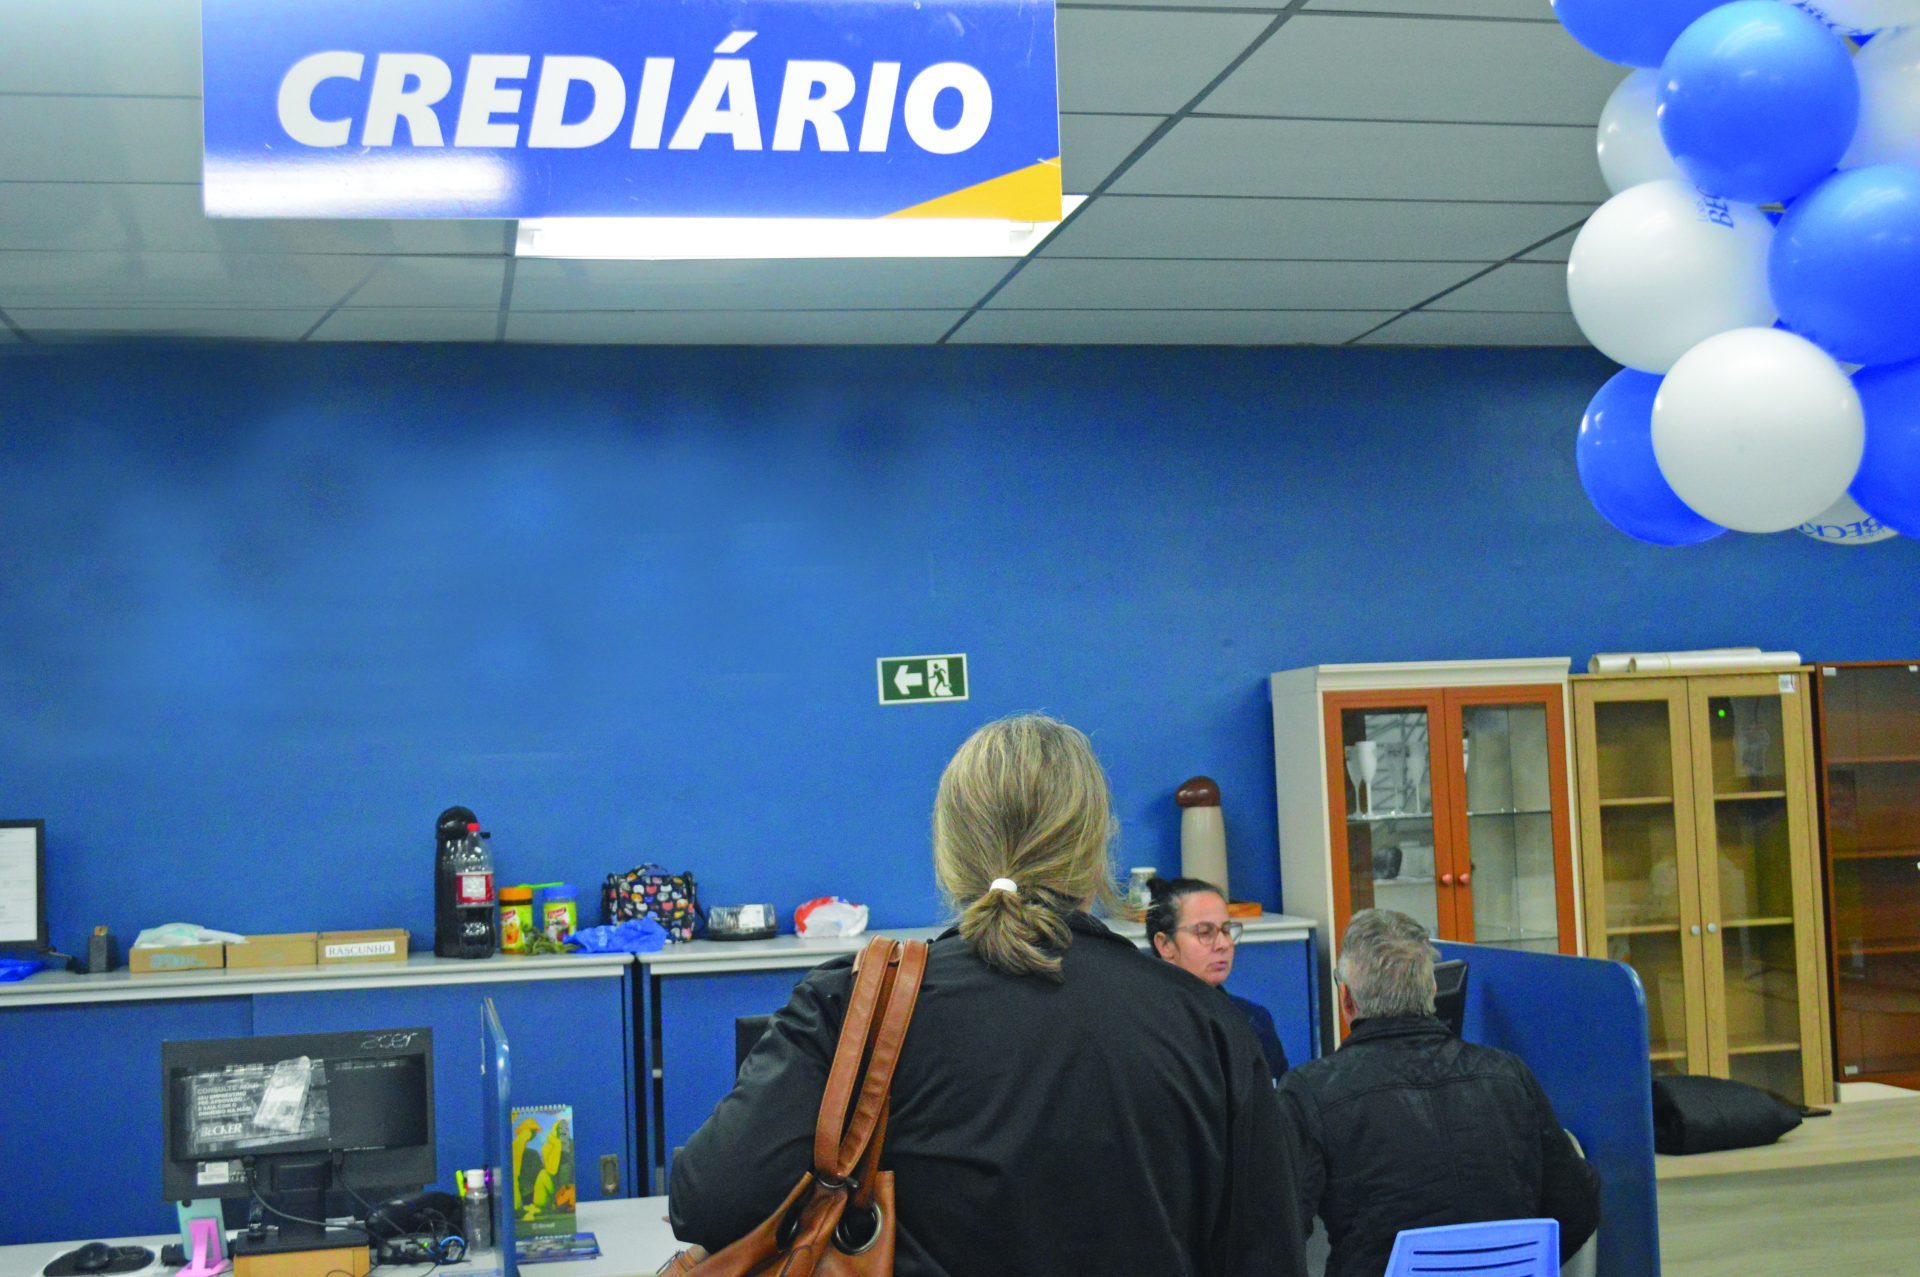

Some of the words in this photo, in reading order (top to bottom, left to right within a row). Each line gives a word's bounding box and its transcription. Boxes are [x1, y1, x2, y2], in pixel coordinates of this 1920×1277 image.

[277, 31, 993, 155] CREDIÁRIO
[328, 944, 391, 957] RASCUNHO
[361, 1032, 418, 1049] acer
[198, 1085, 236, 1094] CONSULTE
[201, 1123, 242, 1136] BECKER
